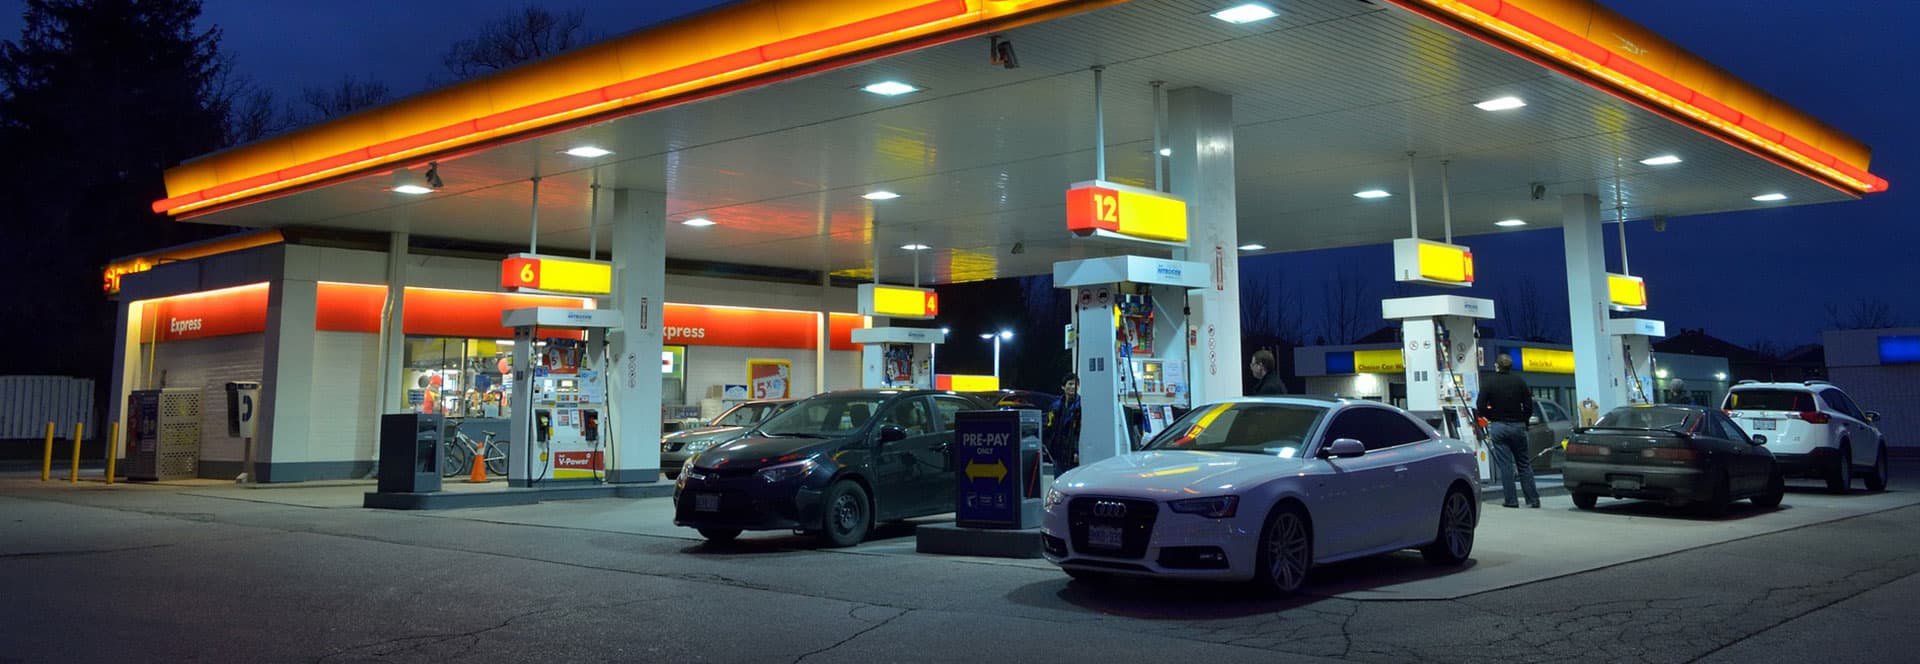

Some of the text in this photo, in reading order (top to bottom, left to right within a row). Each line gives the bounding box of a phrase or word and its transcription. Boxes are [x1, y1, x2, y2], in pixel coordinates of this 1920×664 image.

[1094, 194, 1118, 222] 12
[520, 263, 534, 283] 6
[927, 296, 935, 312] 4
[170, 317, 202, 335] Express
[663, 326, 705, 340] xpress
[962, 432, 1010, 447] PRE-PAY
[976, 447, 994, 456] ONLY
[558, 457, 589, 466] V-Power
